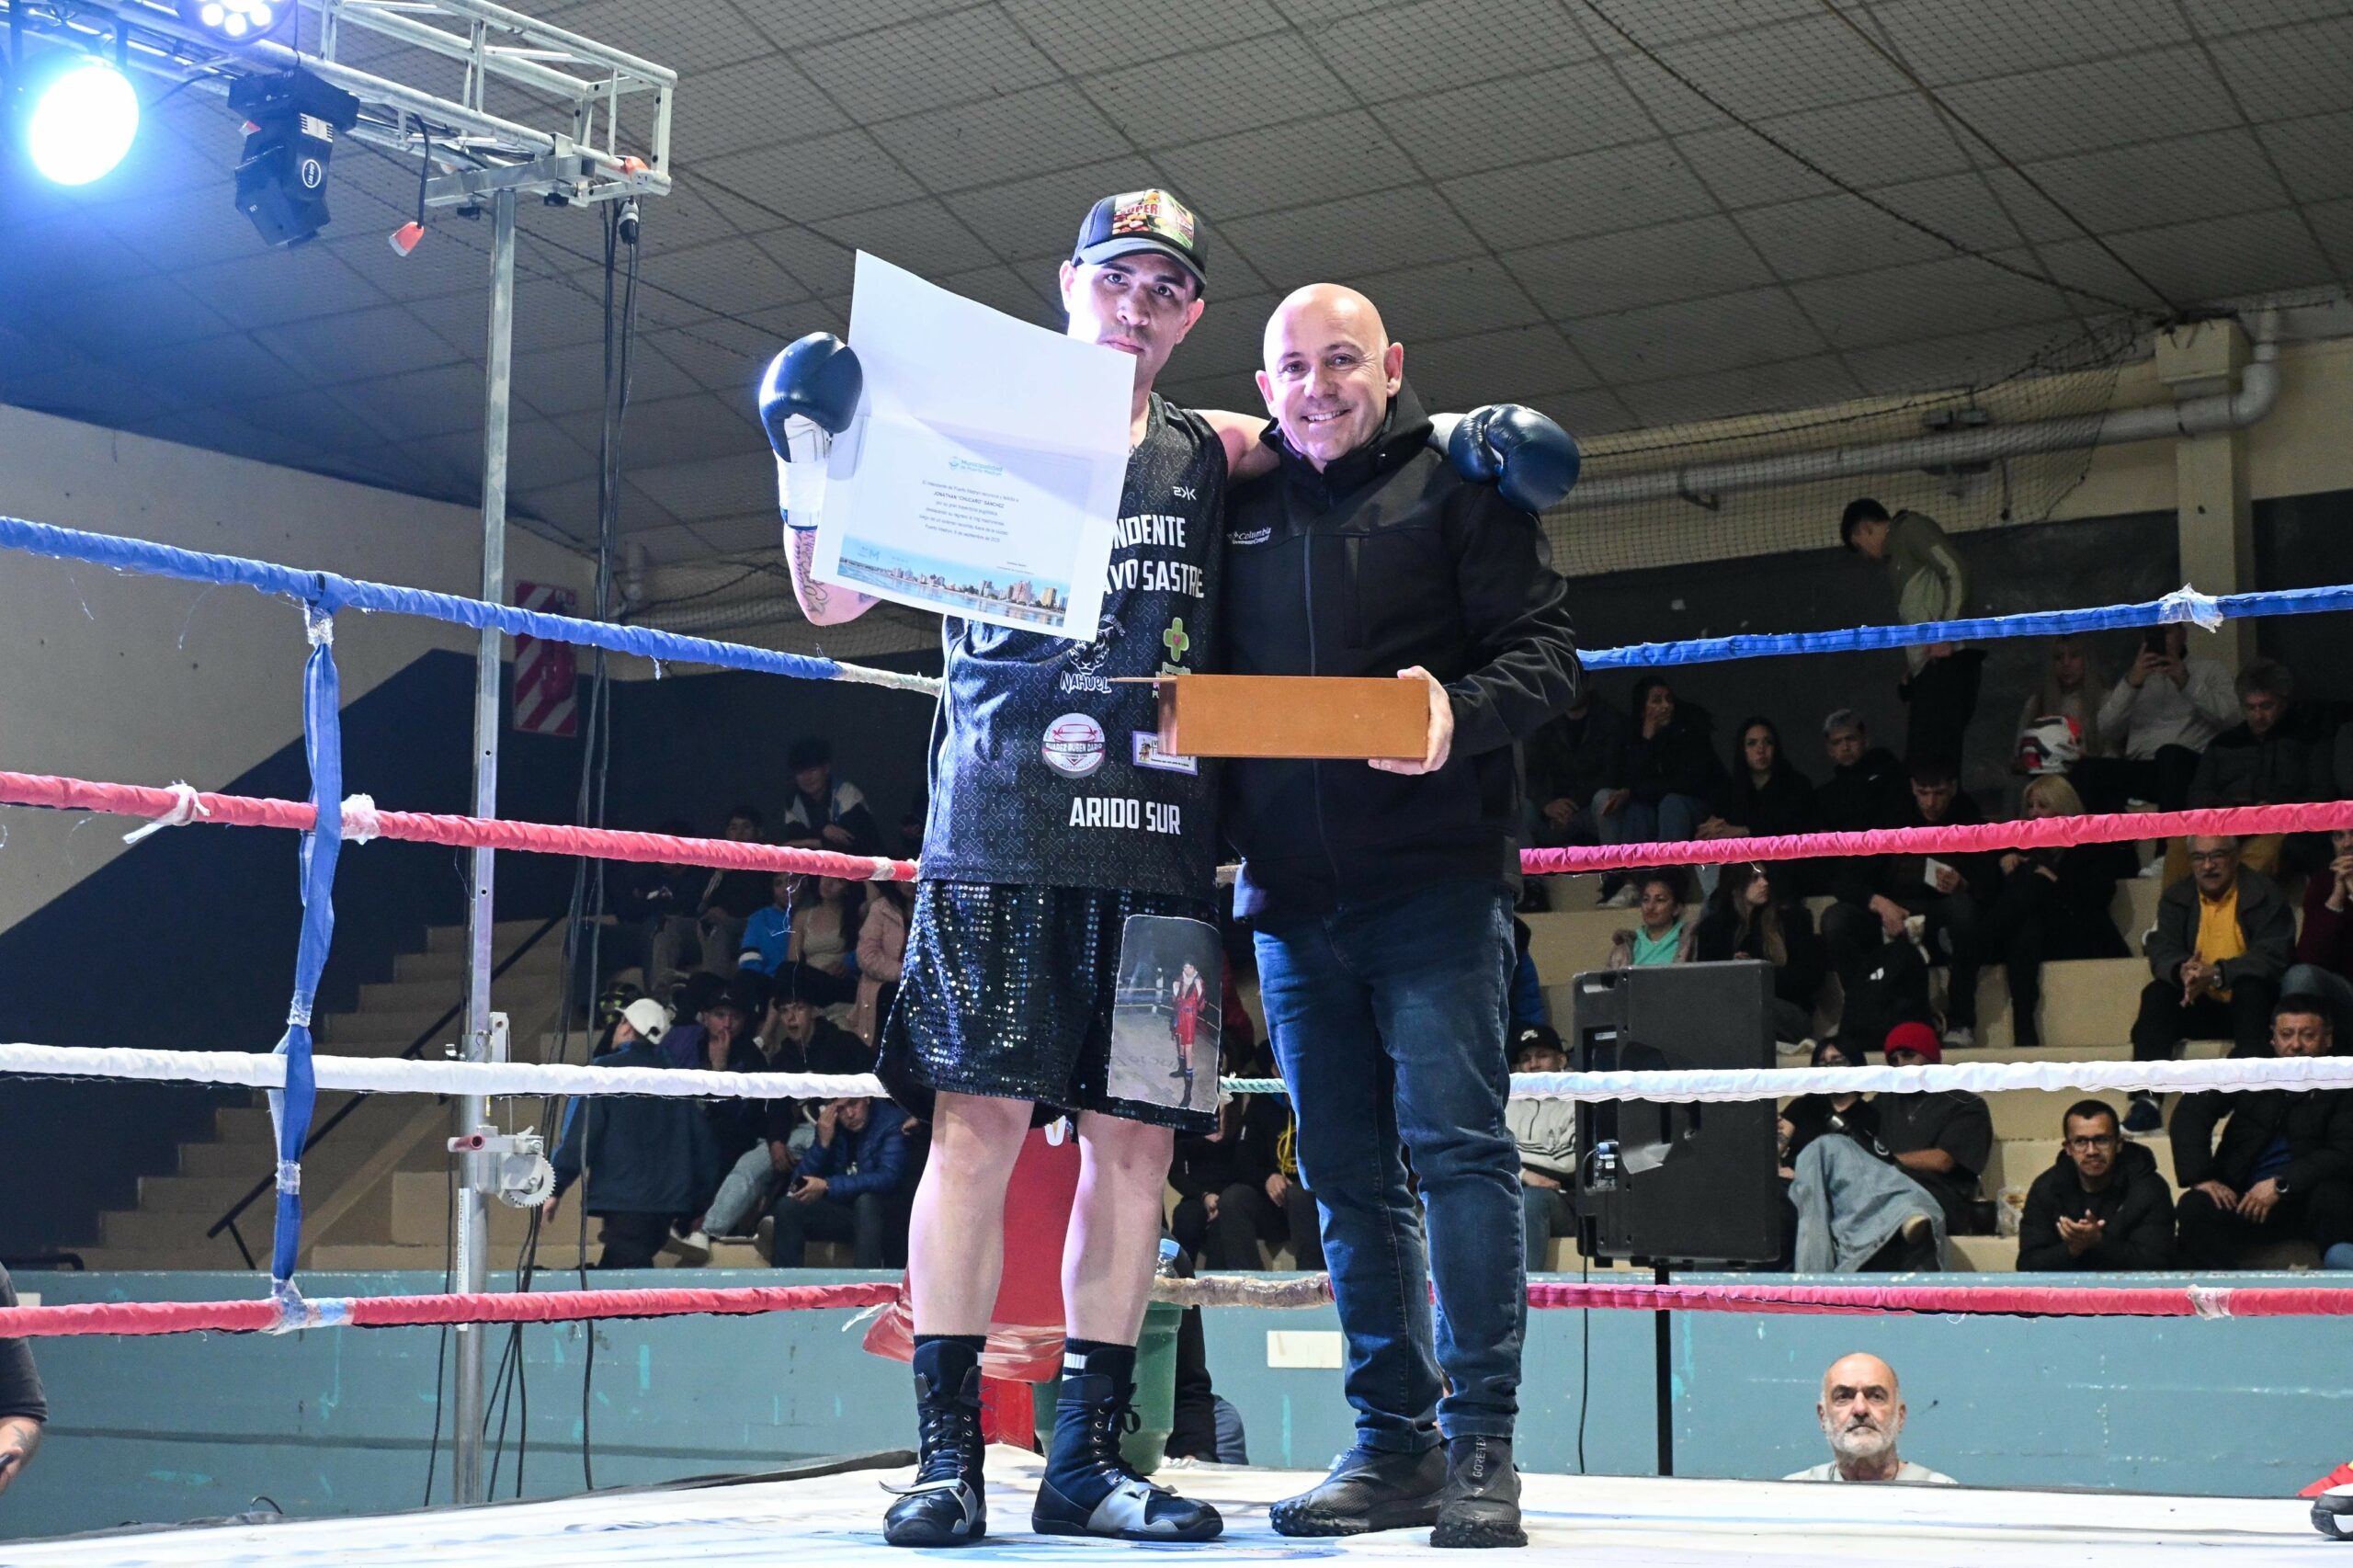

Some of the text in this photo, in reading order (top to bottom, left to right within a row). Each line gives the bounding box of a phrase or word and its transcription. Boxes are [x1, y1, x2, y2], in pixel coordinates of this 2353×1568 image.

[1113, 514, 1186, 550] NDENTE
[1142, 561, 1204, 598] SASTRE
[1069, 797, 1181, 835] ARIDO SUR
